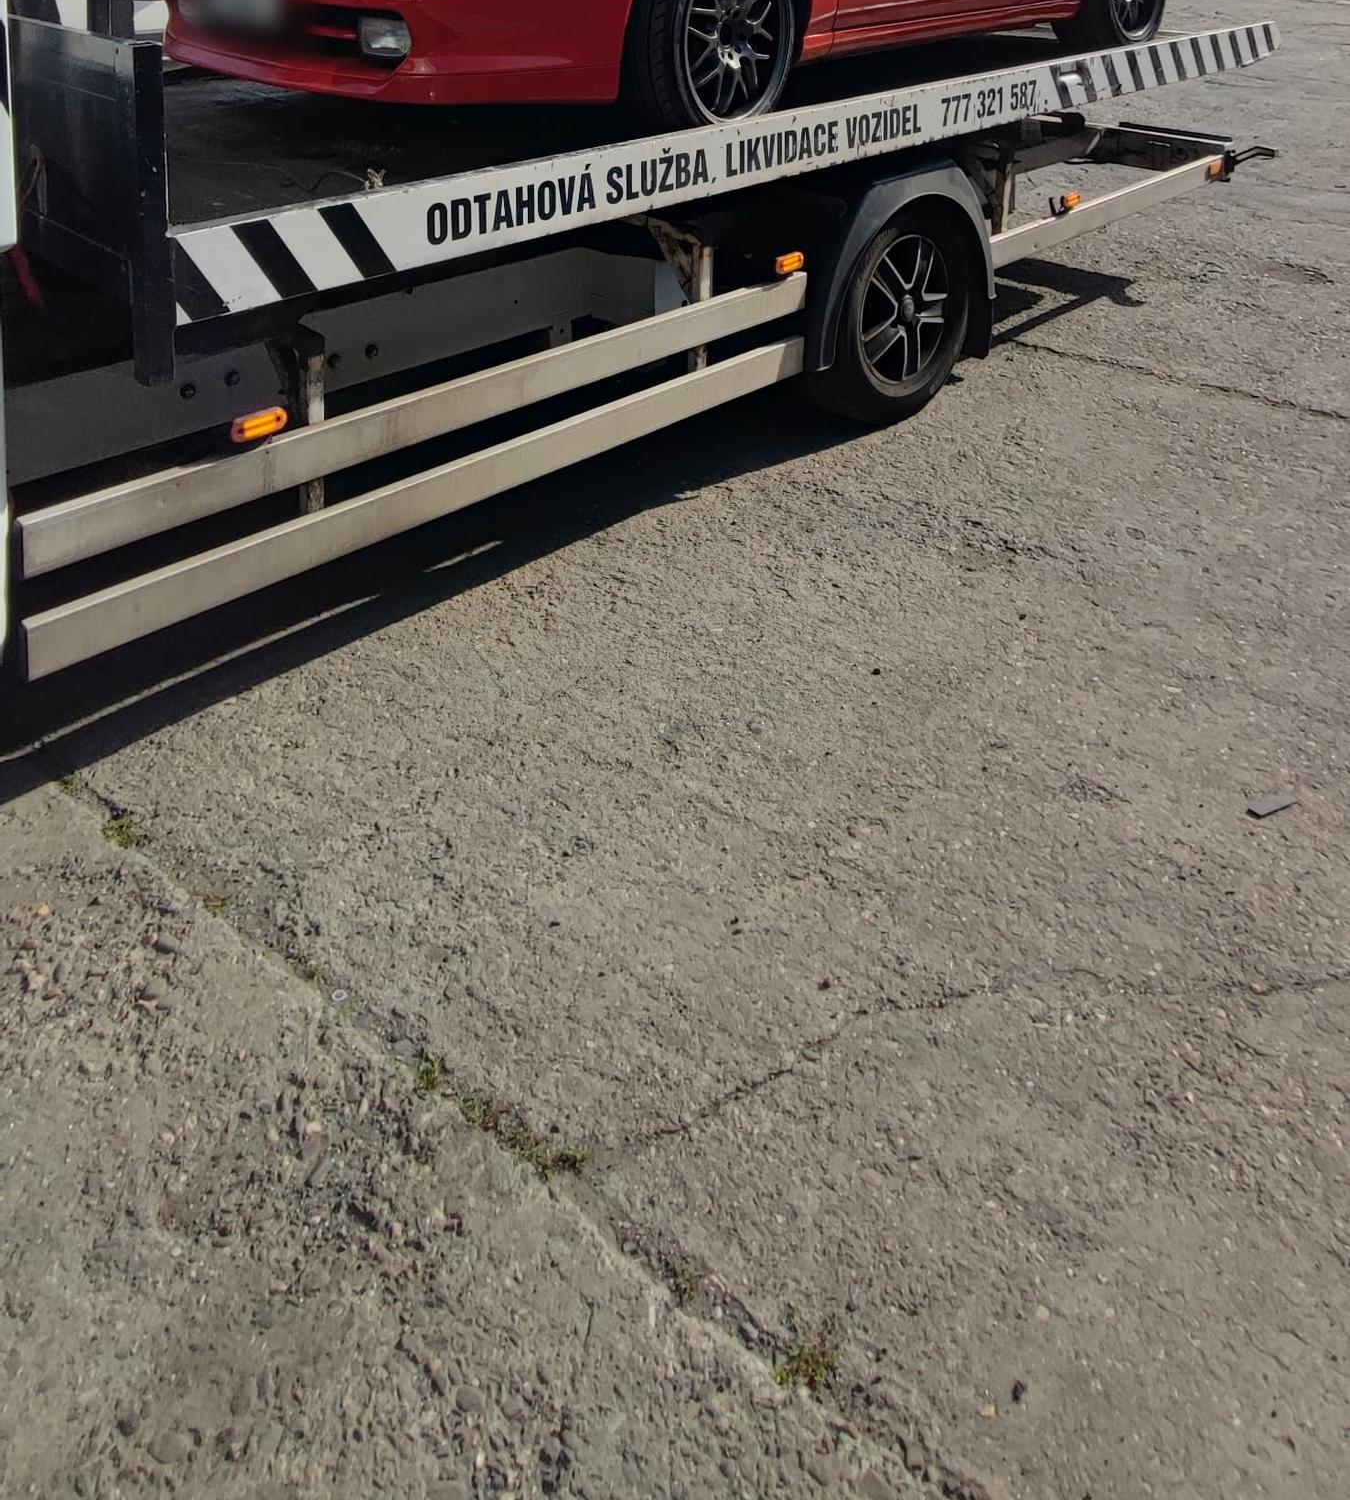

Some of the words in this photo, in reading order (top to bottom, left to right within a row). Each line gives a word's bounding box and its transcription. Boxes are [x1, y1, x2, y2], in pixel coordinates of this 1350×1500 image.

[426, 163, 596, 246] ODTAHOVÁ
[606, 147, 717, 205] SLUŽBA,
[725, 120, 839, 179] LIKVIDACE
[846, 104, 922, 149] VOZIDEL
[941, 92, 971, 127] 777
[977, 86, 1004, 119] 321
[1010, 80, 1037, 111] 587
